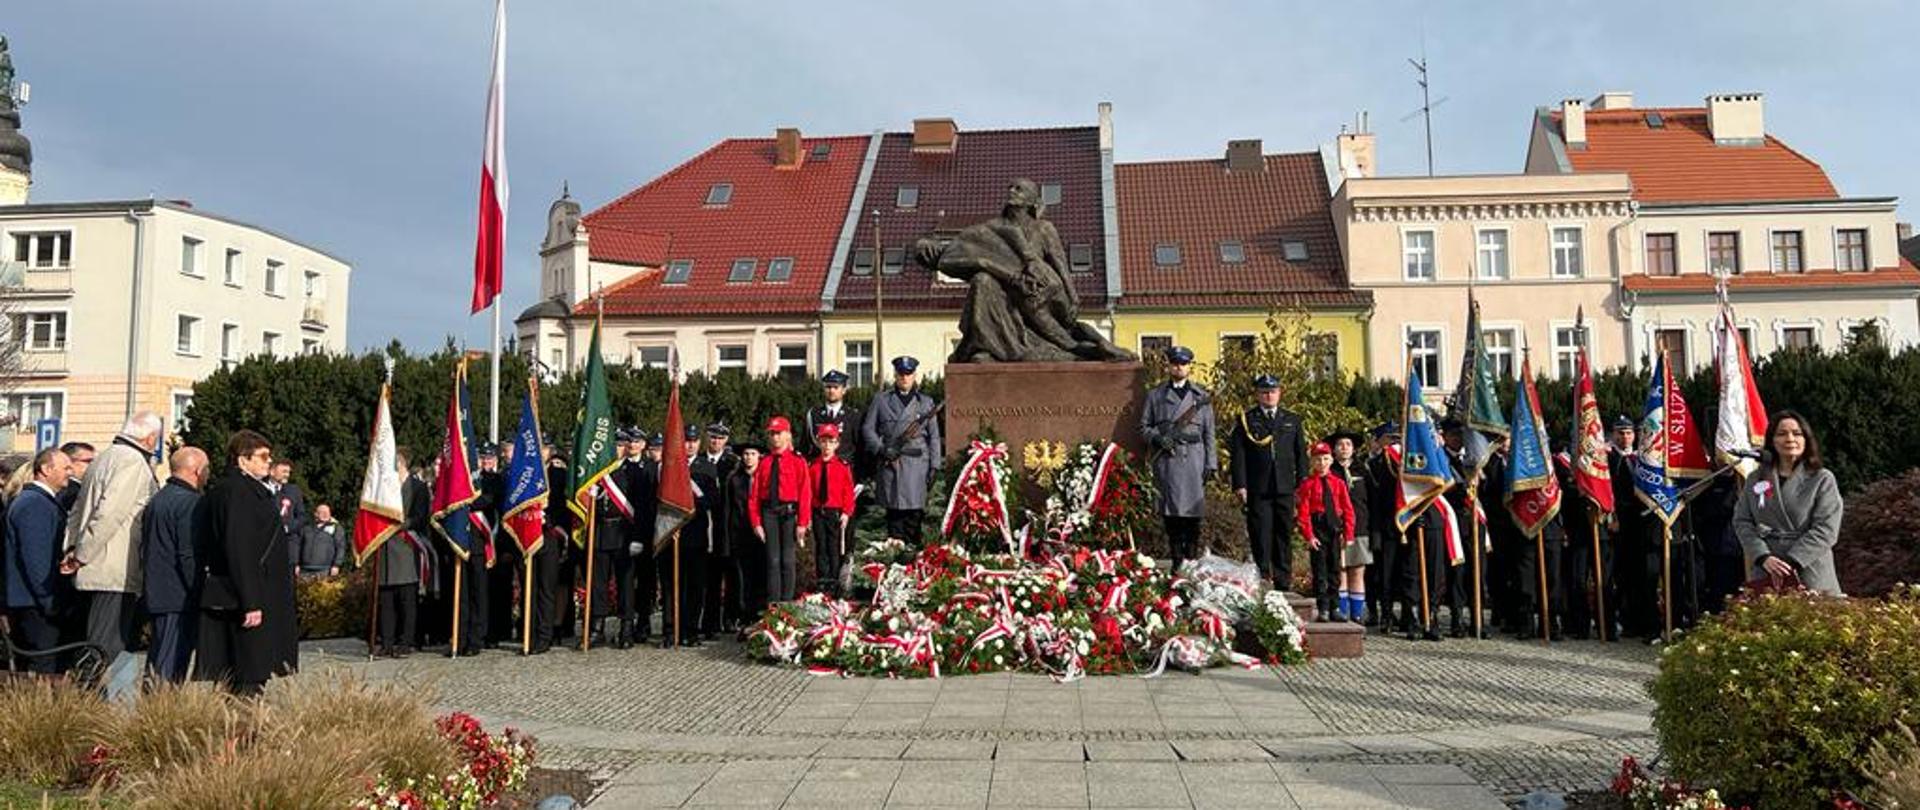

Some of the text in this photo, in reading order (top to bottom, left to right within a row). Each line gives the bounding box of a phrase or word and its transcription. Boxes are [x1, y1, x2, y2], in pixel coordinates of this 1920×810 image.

[41, 424, 55, 451] P
[585, 417, 610, 464] NOBIS
[1670, 443, 1685, 456] W
